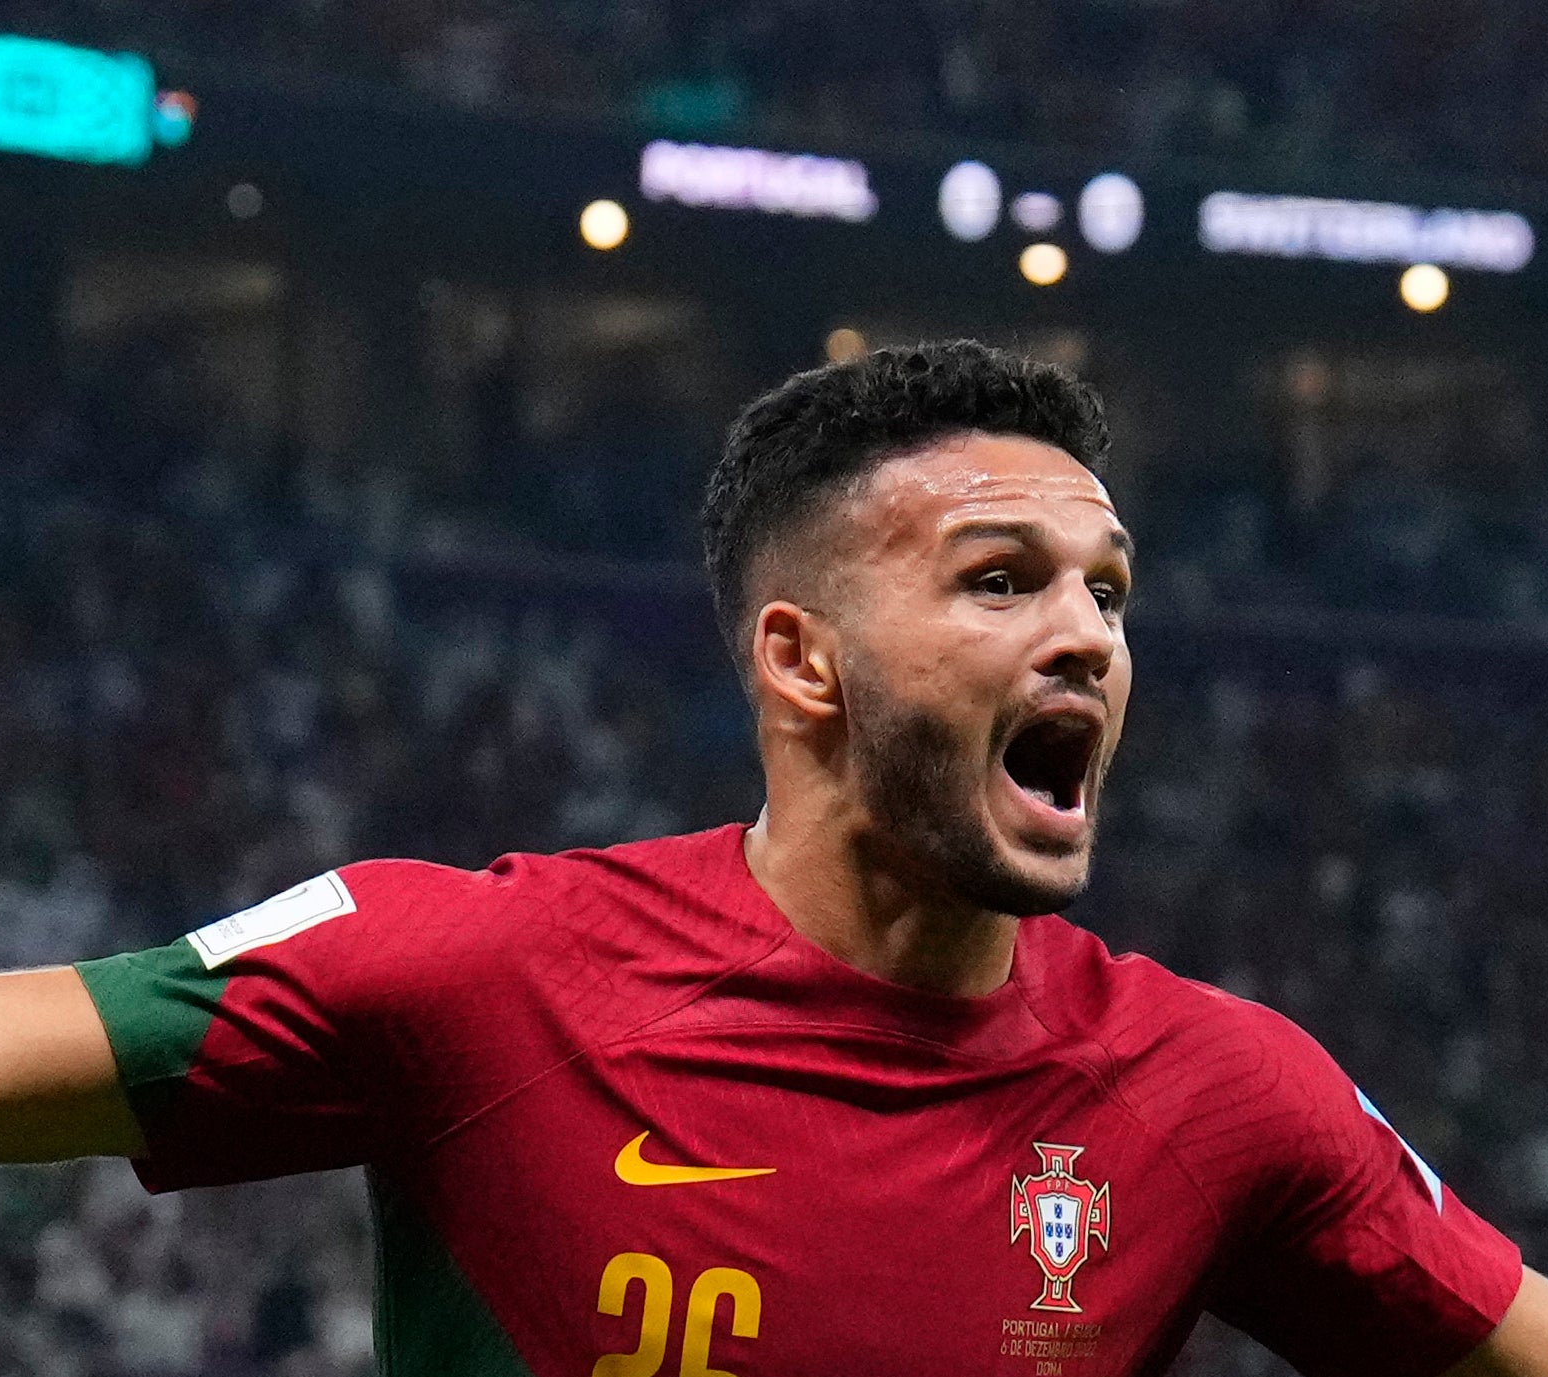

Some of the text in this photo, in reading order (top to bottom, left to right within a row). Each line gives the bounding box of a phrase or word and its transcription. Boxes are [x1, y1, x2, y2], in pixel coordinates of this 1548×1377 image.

[1002, 1318, 1059, 1338] PORTUGAL
[1000, 1340, 1008, 1355] 6
[1010, 1339, 1023, 1356] DE
[1025, 1340, 1073, 1358] DEZEMBRO
